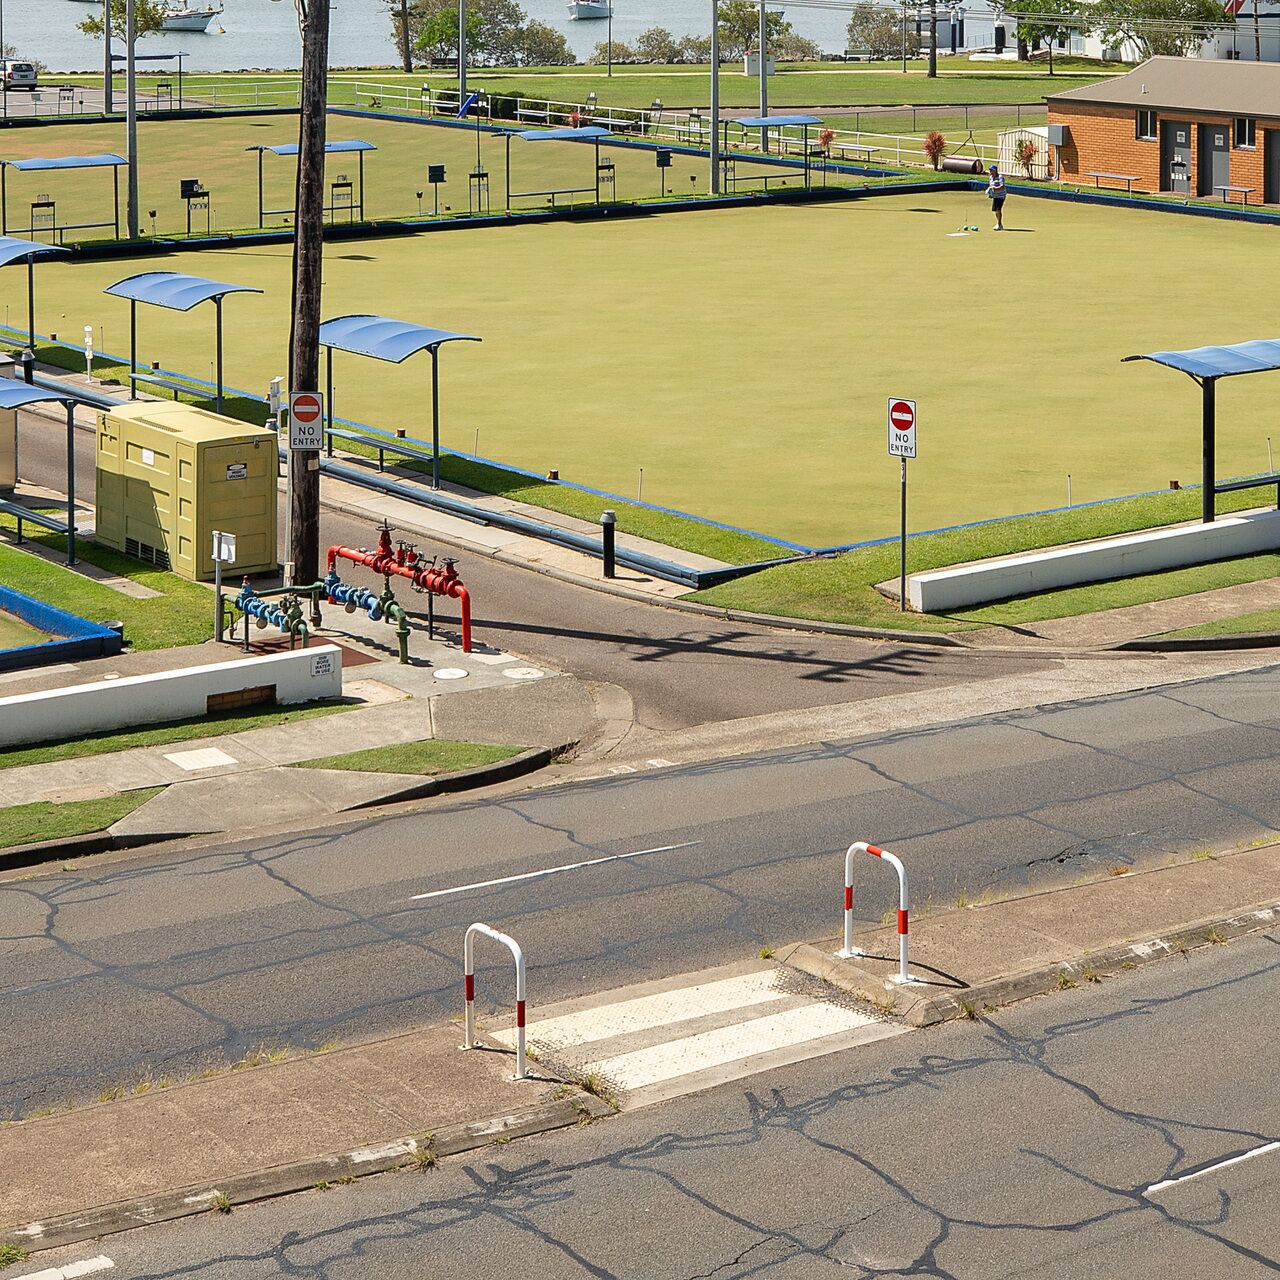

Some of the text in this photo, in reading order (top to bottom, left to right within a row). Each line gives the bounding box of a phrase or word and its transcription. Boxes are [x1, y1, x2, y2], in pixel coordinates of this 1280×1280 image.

[298, 426, 315, 436] NO
[292, 437, 321, 446] ENTRY
[895, 433, 909, 443] NO
[890, 443, 914, 454] ENTRY
